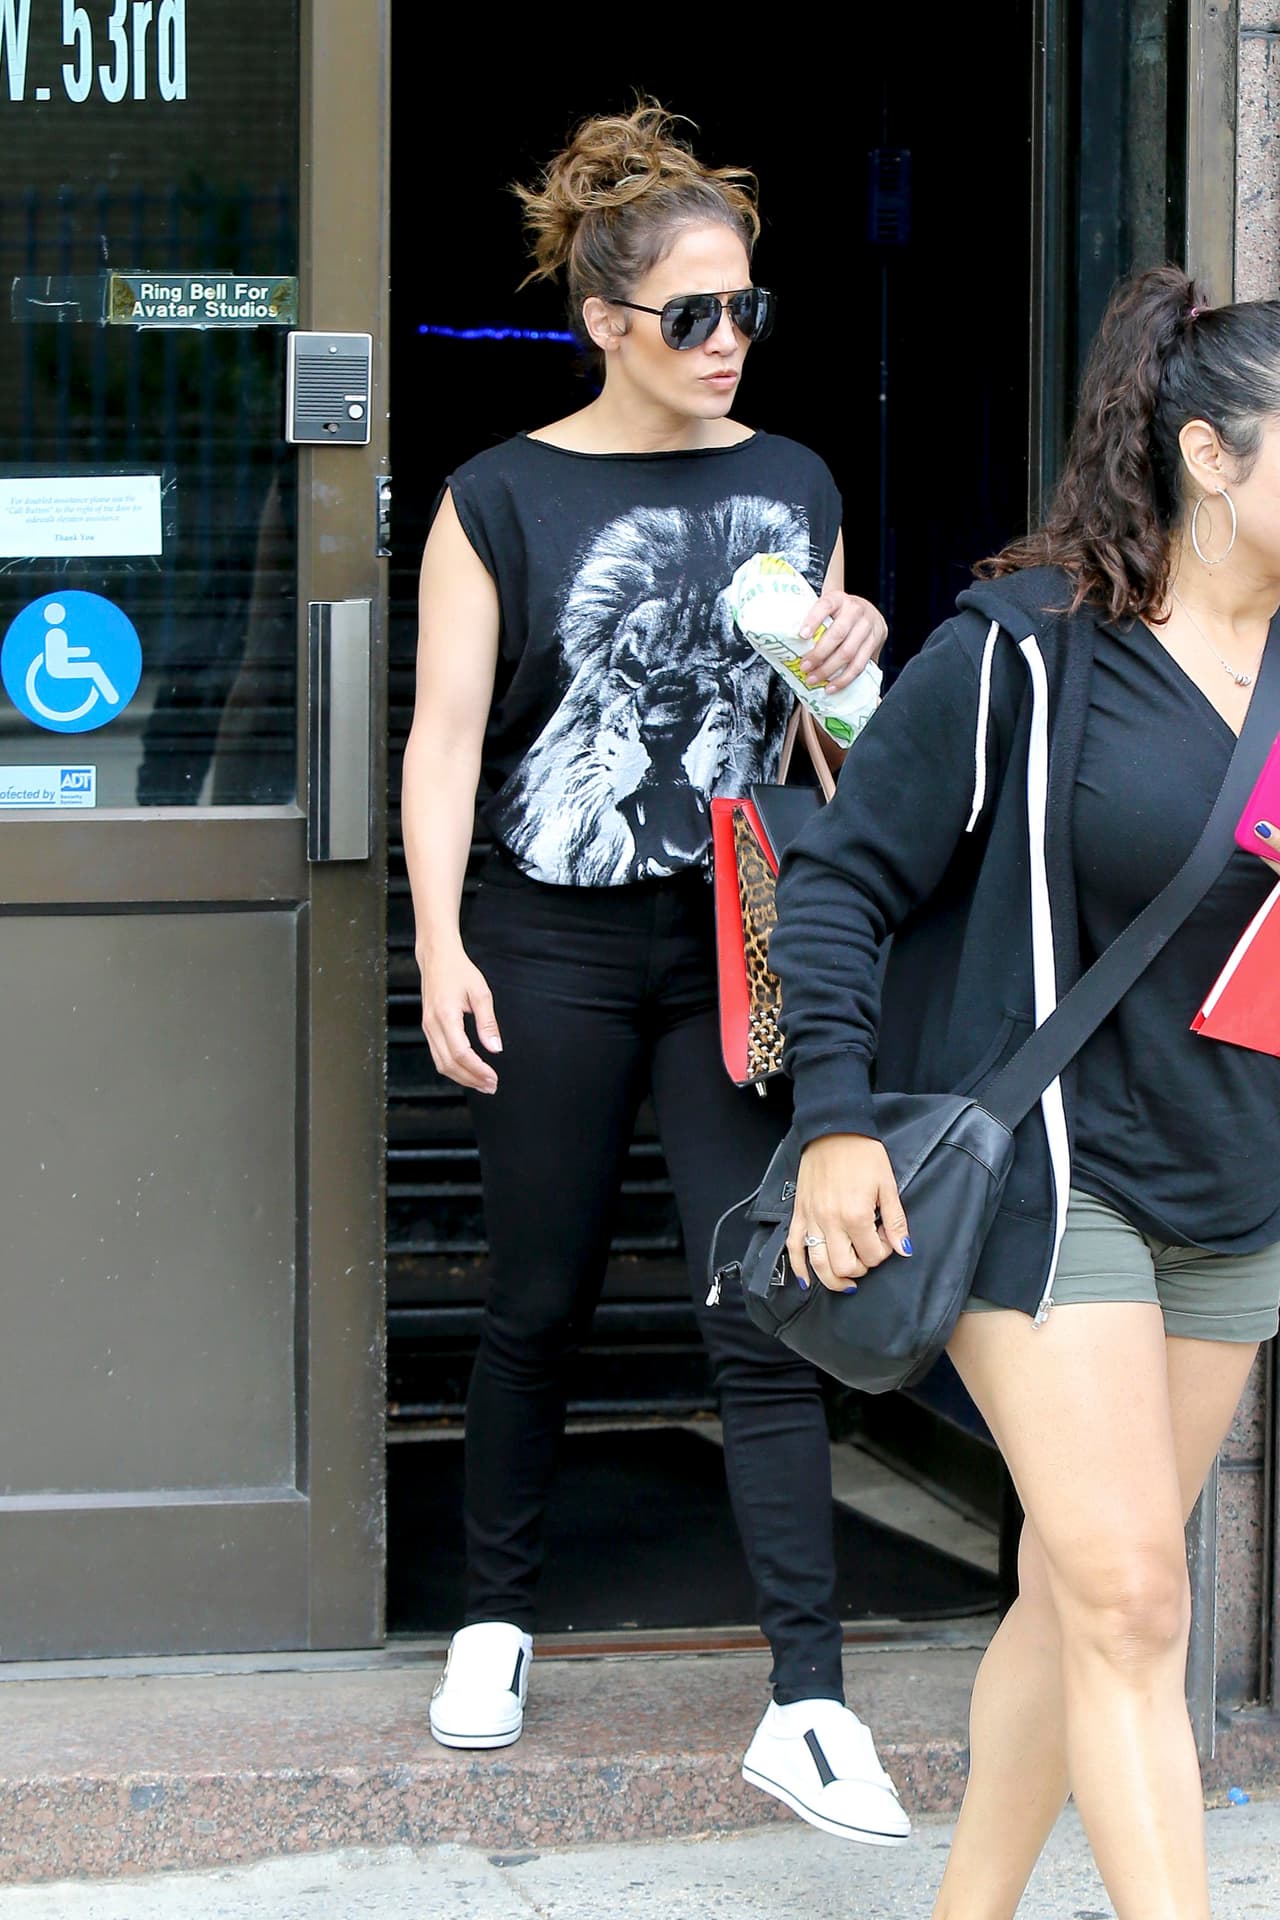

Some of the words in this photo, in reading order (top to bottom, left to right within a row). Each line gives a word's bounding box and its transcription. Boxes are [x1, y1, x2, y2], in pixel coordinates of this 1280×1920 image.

[62, 0, 187, 103] 53rd
[140, 283, 183, 302] Ring
[190, 283, 227, 300] Bell
[234, 283, 269, 300] For
[131, 301, 197, 318] Avatar
[205, 301, 279, 318] Studios
[60, 771, 92, 789] ADT
[42, 789, 56, 801] by
